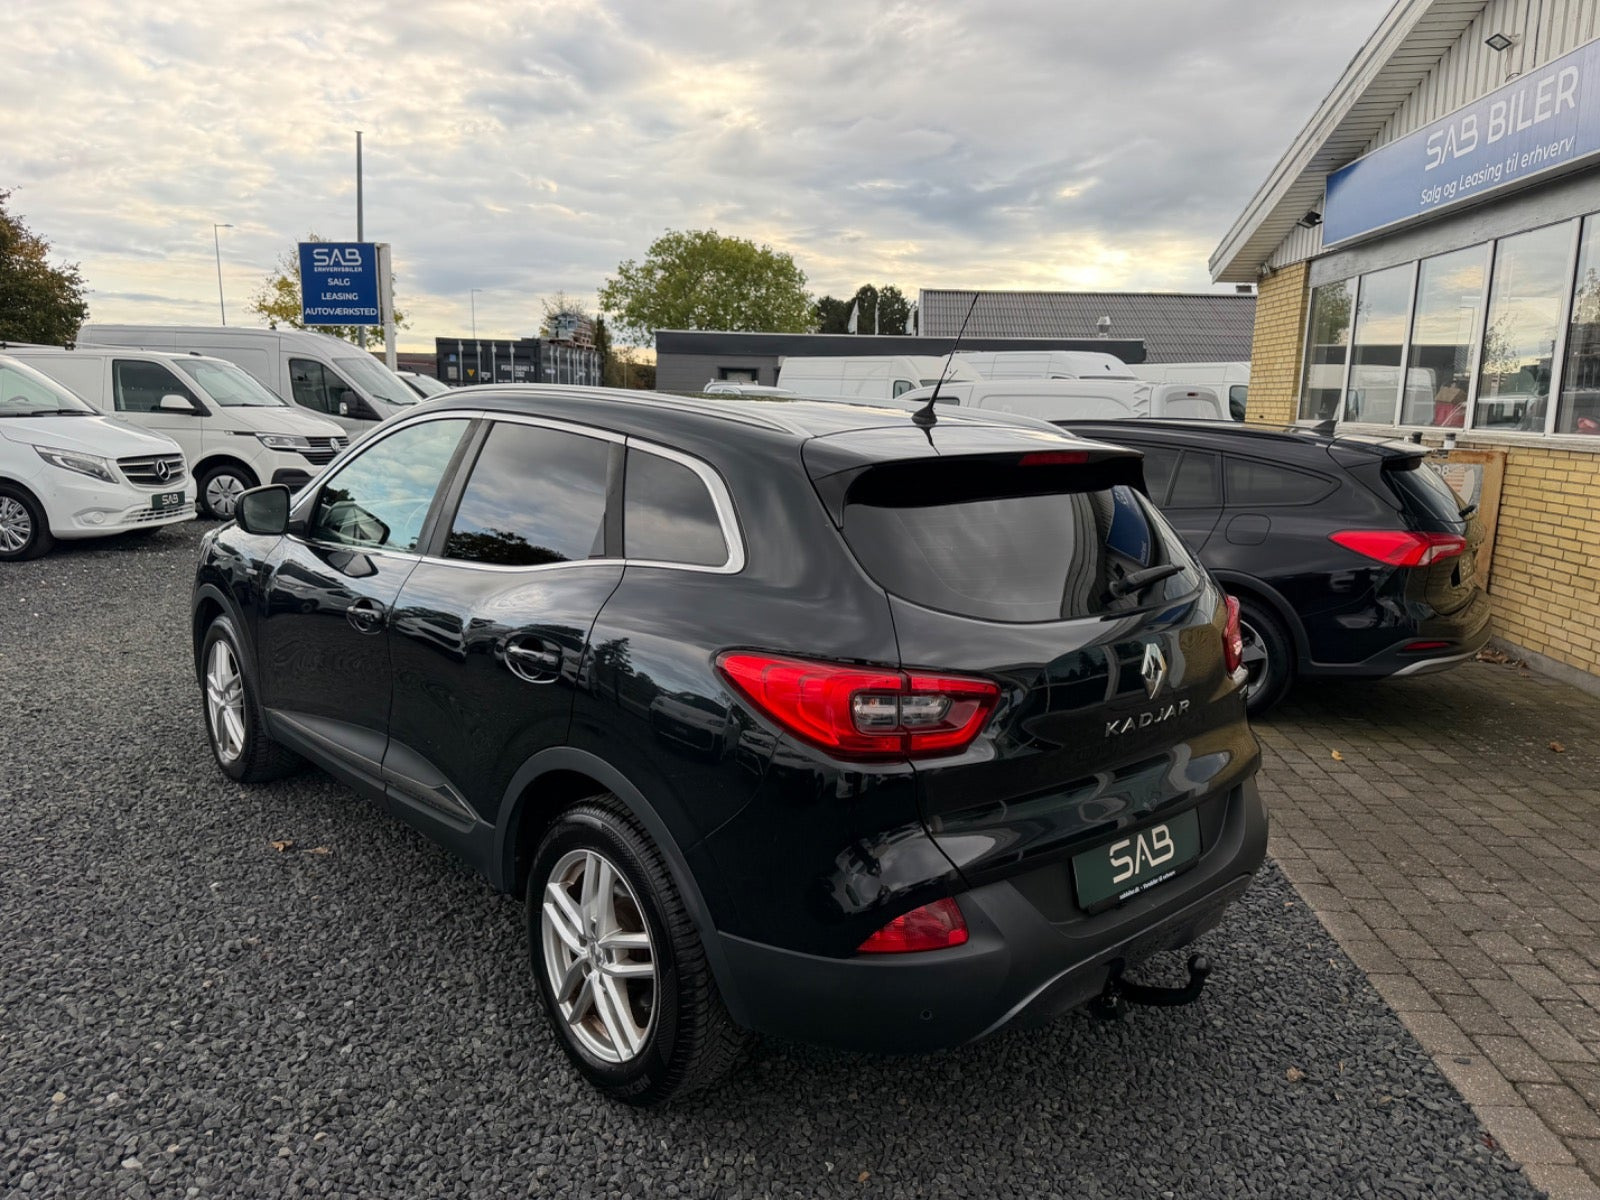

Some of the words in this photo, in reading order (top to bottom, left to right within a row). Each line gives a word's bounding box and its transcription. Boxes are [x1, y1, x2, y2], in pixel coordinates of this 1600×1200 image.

[1424, 113, 1479, 171] SAB
[1487, 65, 1580, 145] BILER
[1420, 184, 1442, 205] Salg
[1443, 181, 1457, 199] og
[1459, 163, 1503, 191] Leasing
[1505, 152, 1519, 175] til
[1520, 135, 1576, 168] erhverv
[312, 248, 362, 266] SAB
[327, 278, 351, 286] SALG
[321, 292, 359, 301] LEASING
[304, 307, 377, 316] AUTOVÆRKSTED
[162, 494, 178, 505] SAB
[1103, 699, 1190, 738] KADJAR
[1109, 824, 1175, 884] SAB
